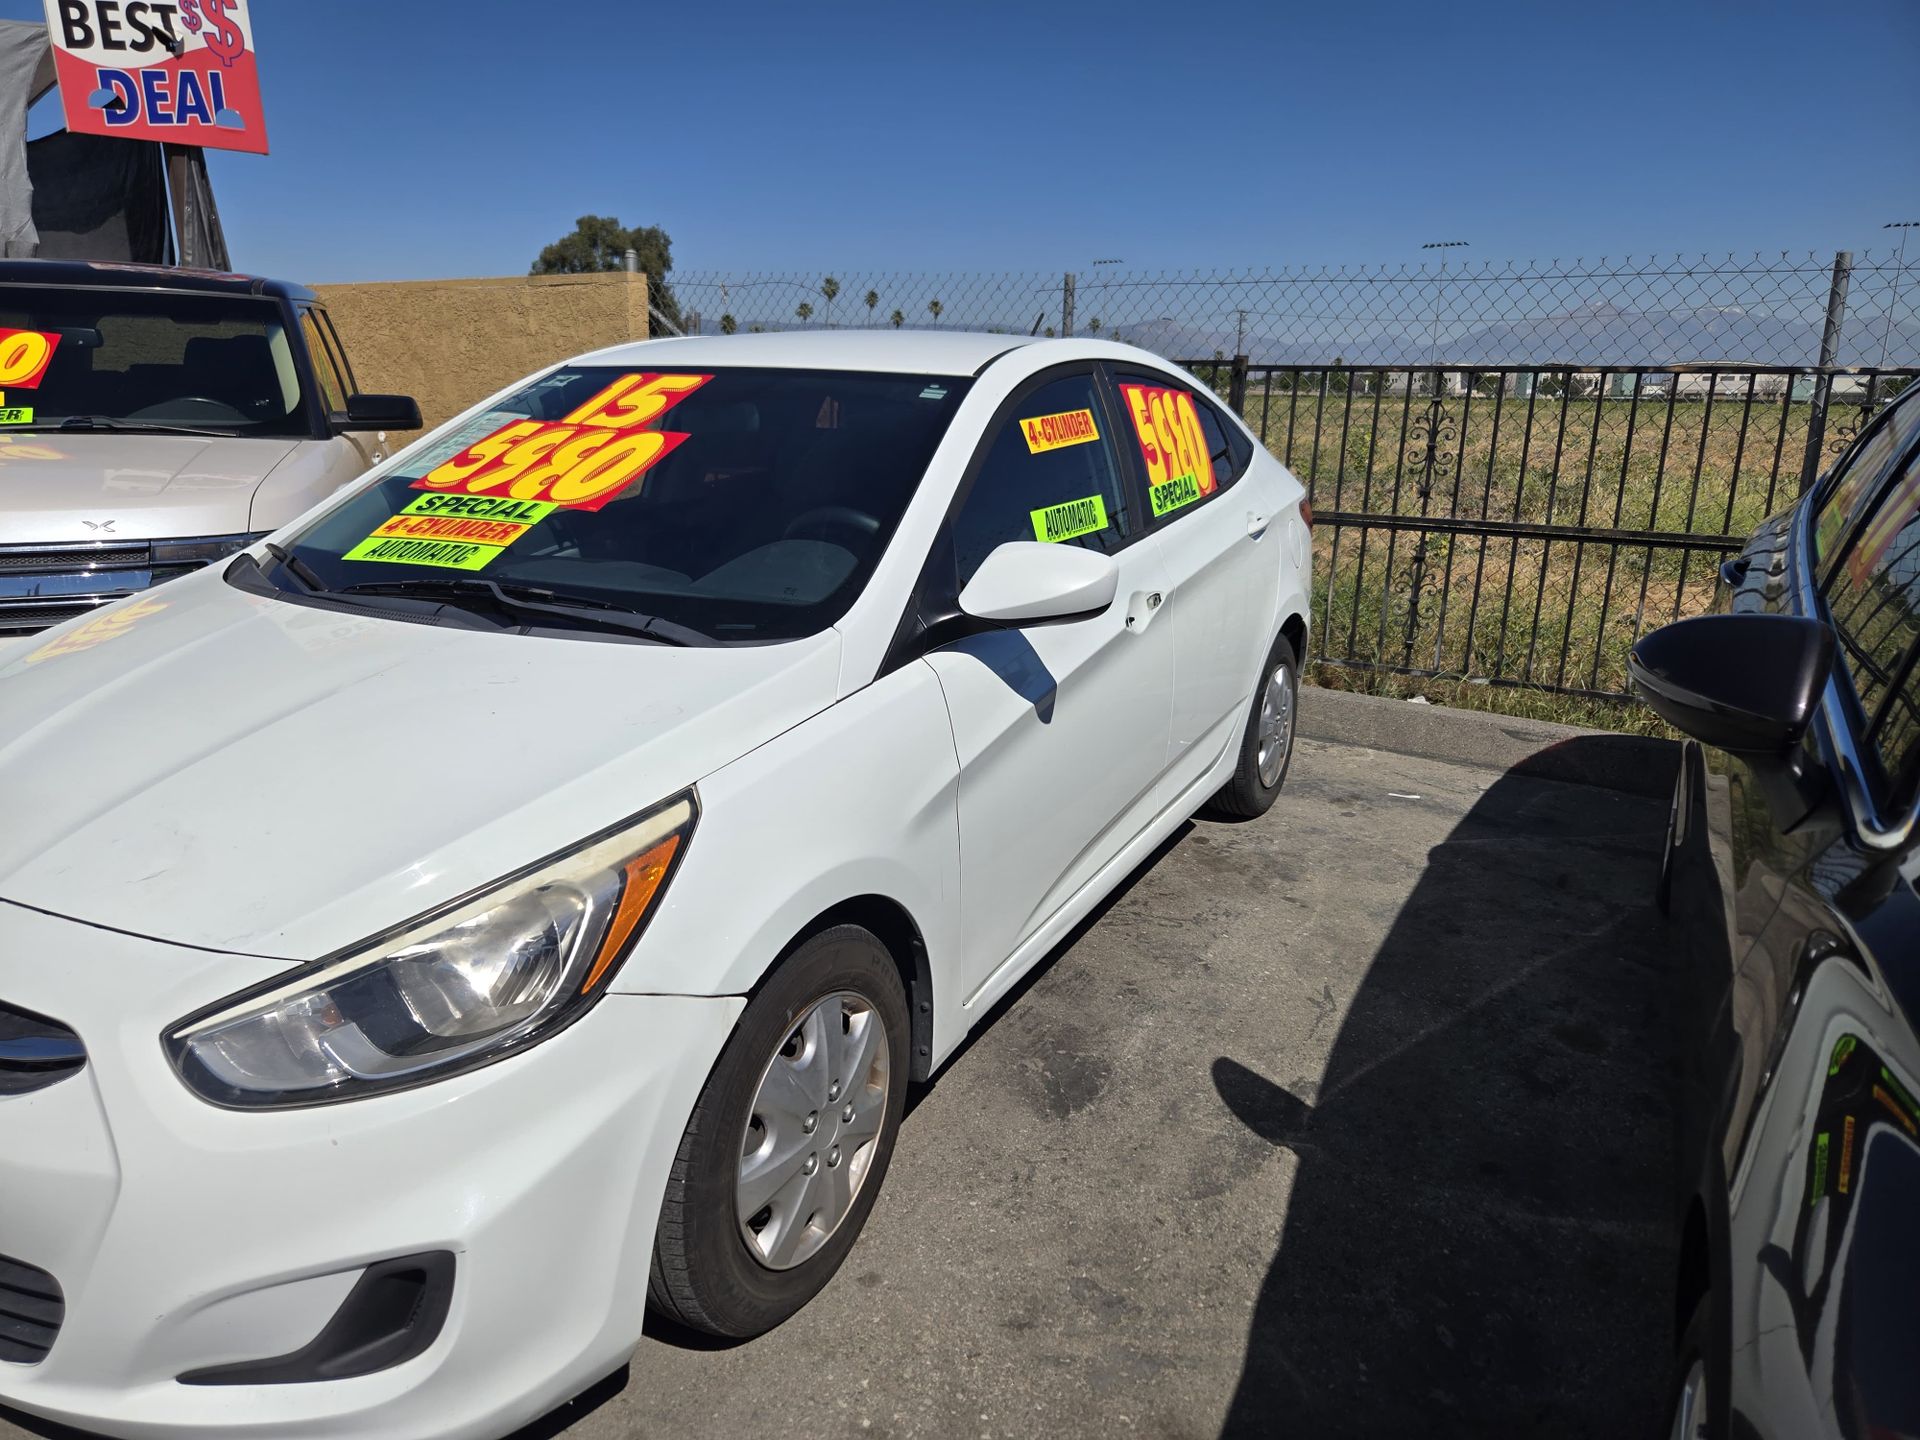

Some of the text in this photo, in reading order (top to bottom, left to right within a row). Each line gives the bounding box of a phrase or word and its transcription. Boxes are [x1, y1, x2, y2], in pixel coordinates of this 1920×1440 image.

[57, 0, 180, 52] BEST
[561, 374, 703, 429] 15
[1028, 411, 1094, 446] 4-CYLINDER
[424, 423, 665, 506] 5980
[415, 494, 541, 521] SPECIAL
[1153, 475, 1198, 512] SPECIAL
[381, 516, 523, 542] 4-CYLINDER
[1044, 499, 1099, 540] AUTOMATIC
[362, 539, 481, 563] AUTOMATIC
